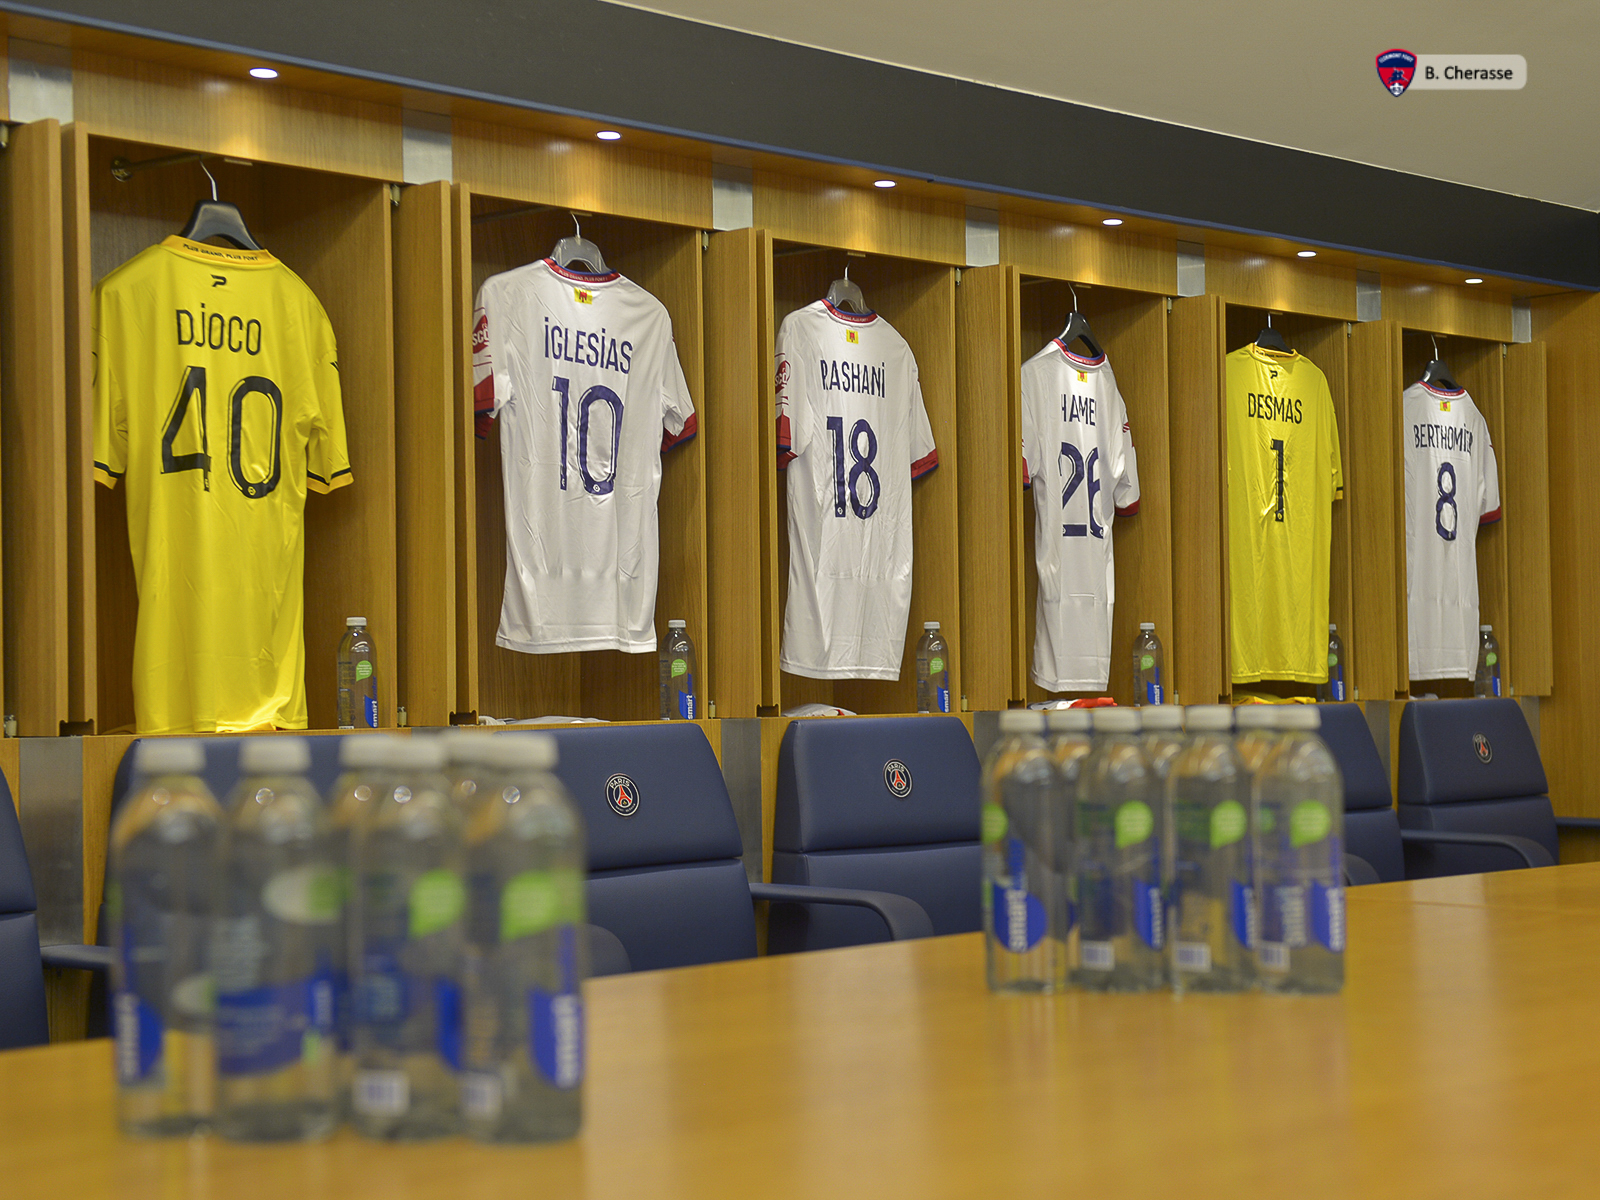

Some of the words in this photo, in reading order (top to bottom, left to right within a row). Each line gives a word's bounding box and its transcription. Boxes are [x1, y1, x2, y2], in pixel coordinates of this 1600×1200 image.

[161, 365, 283, 499] 40
[552, 376, 624, 496] 10
[1061, 394, 1097, 426] HAME
[1248, 392, 1302, 424] DESMAS
[827, 416, 880, 520] 18
[1058, 442, 1104, 539] 26
[1270, 439, 1284, 522] 1
[1436, 462, 1457, 541] 8
[610, 778, 630, 789] PARIS
